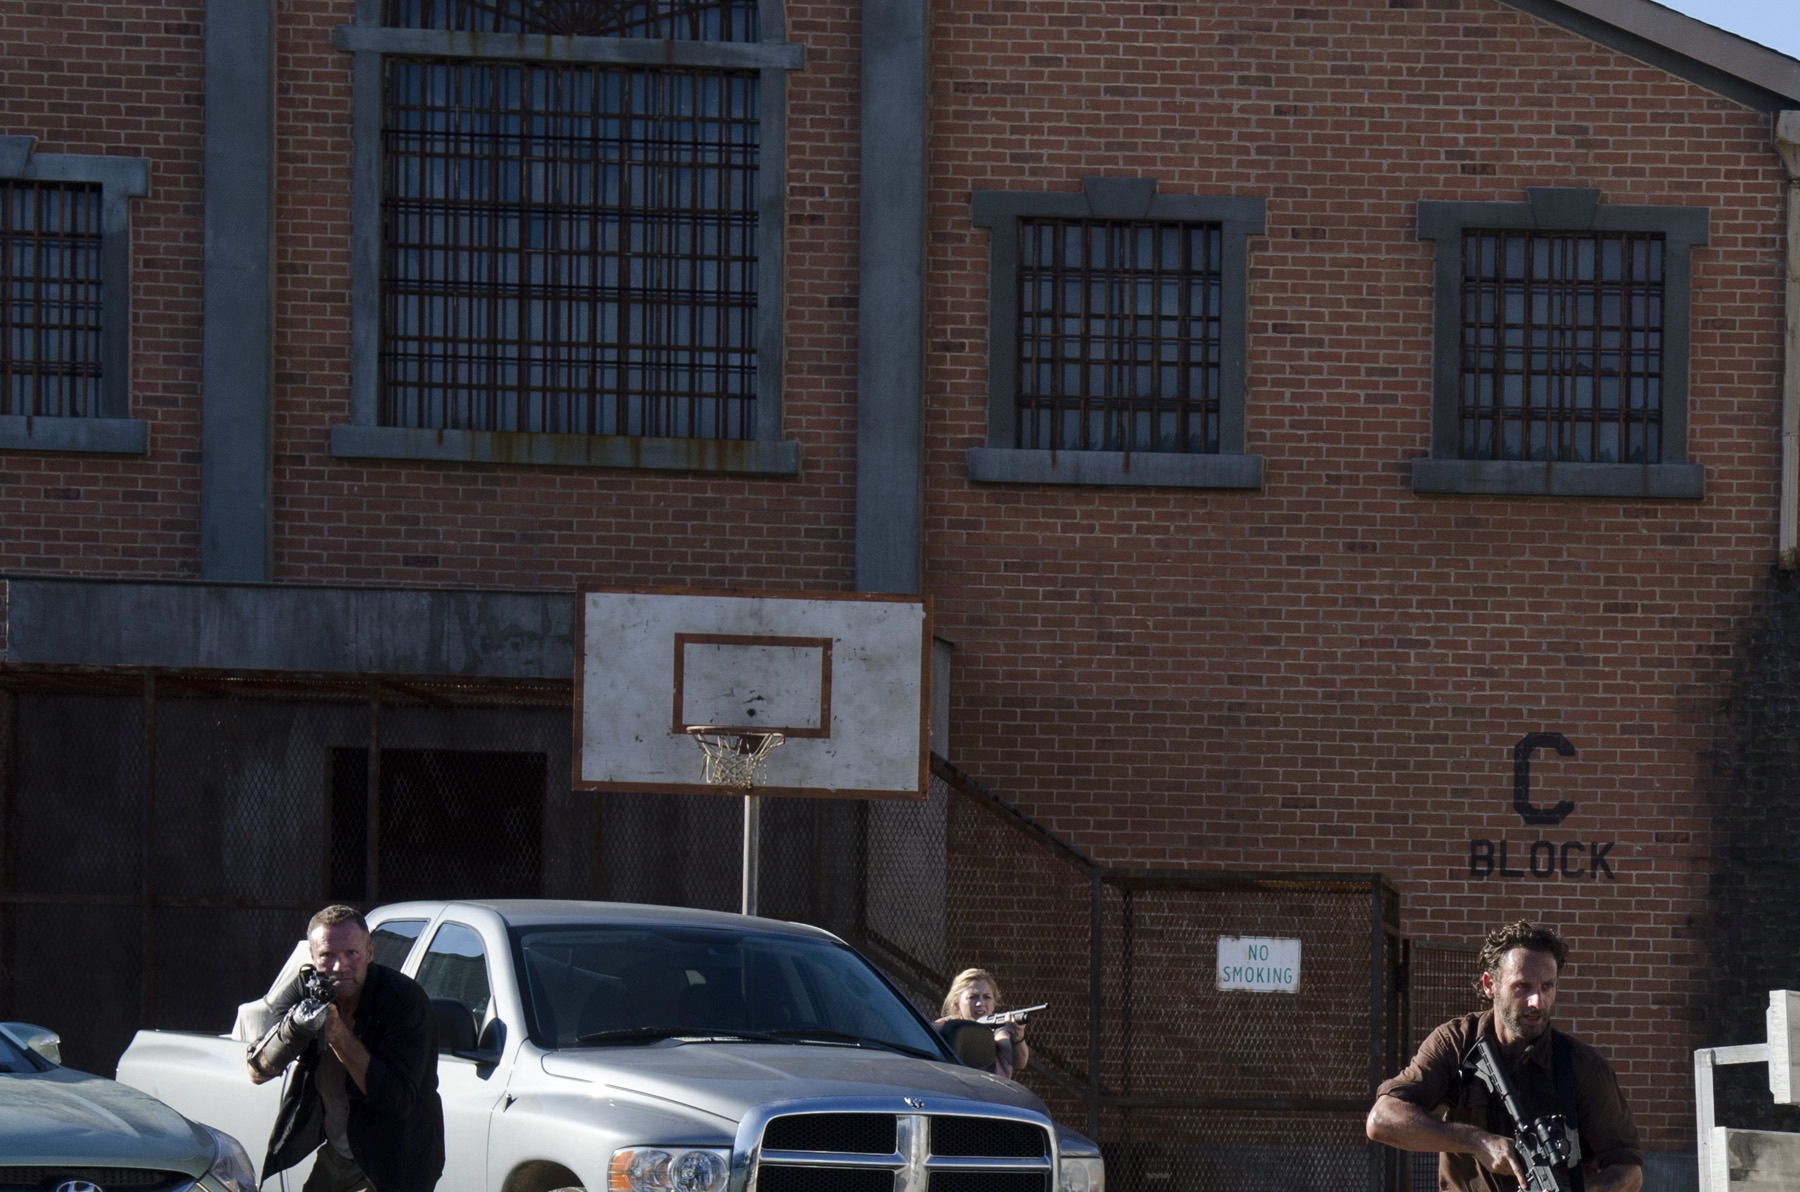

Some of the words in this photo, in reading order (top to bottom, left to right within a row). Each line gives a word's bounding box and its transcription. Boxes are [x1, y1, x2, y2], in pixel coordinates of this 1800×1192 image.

[1513, 732, 1576, 825] C
[1469, 839, 1616, 879] BLOCK
[1248, 944, 1269, 961] NO
[1223, 966, 1293, 984] SMOKING
